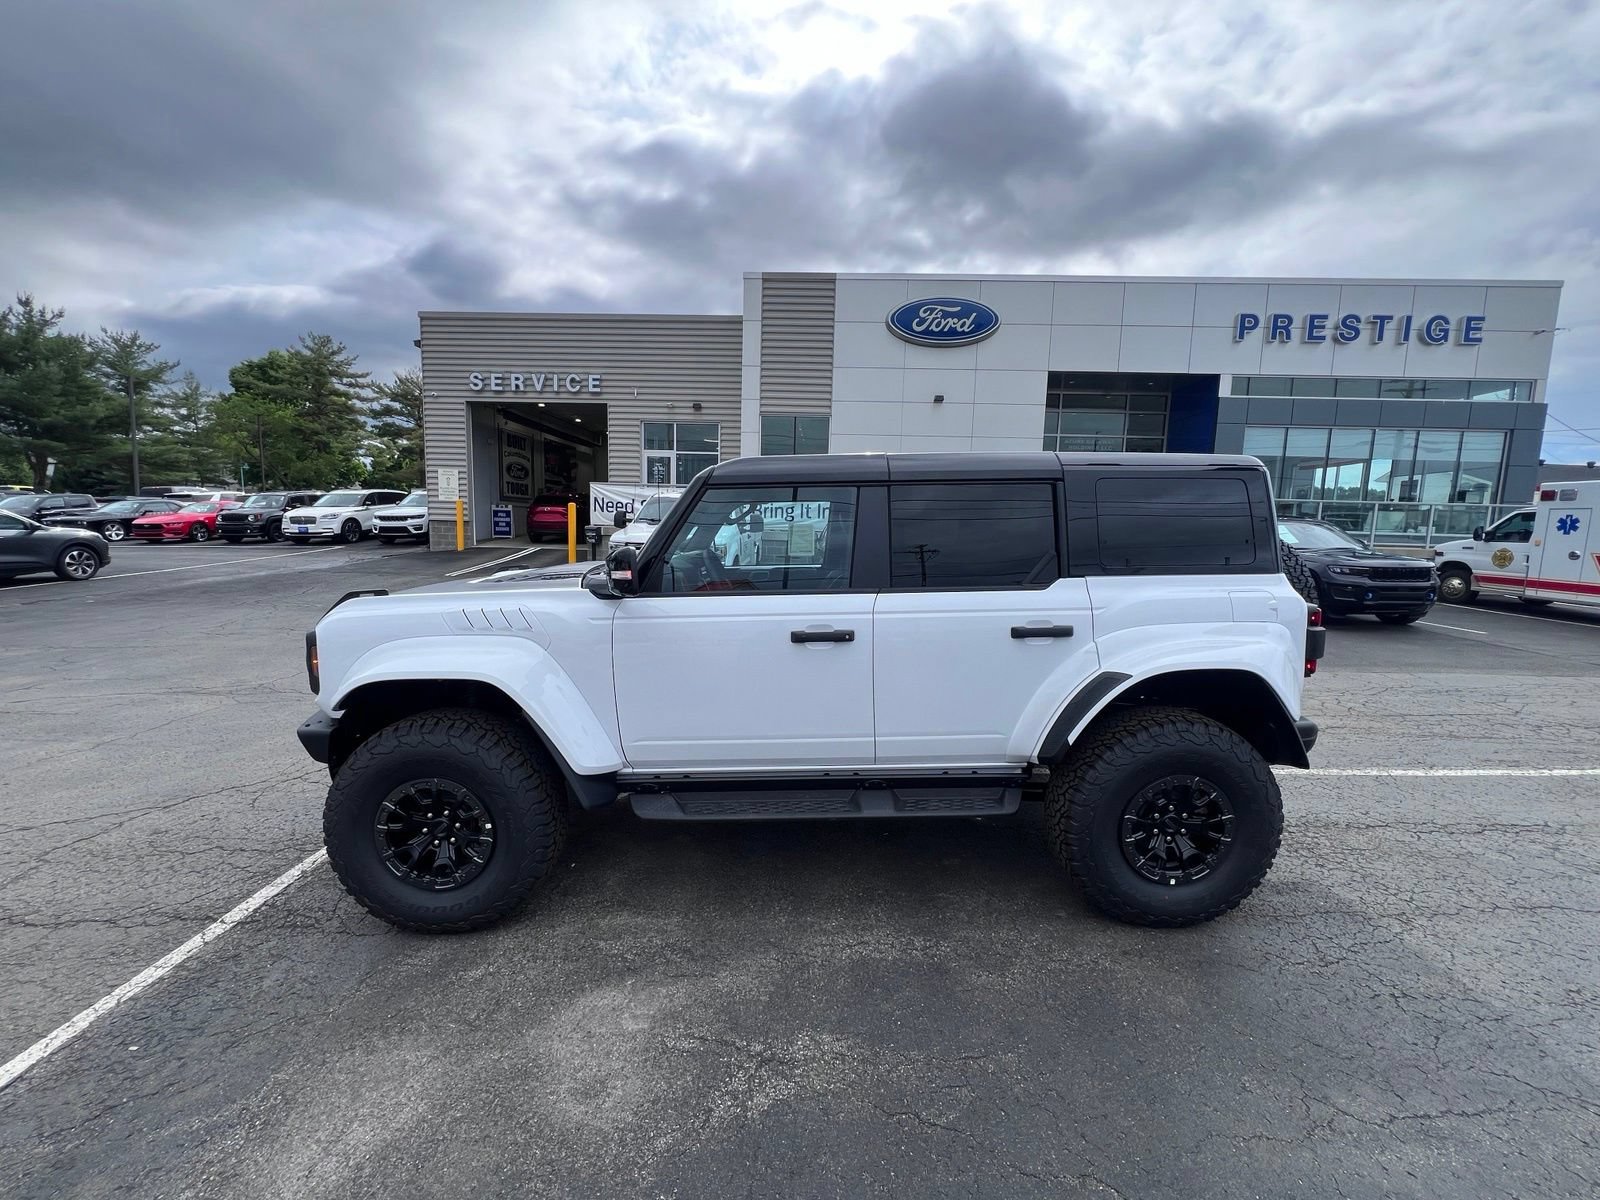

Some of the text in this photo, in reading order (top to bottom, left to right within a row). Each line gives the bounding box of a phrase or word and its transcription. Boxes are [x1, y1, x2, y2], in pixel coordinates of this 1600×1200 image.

[912, 305, 977, 332] Ford
[1236, 313, 1486, 344] PRESTIGE
[469, 372, 601, 393] SERVICE
[510, 463, 526, 478] Ford
[506, 481, 529, 496] TOUGH
[593, 496, 635, 514] Need
[800, 503, 812, 519] It
